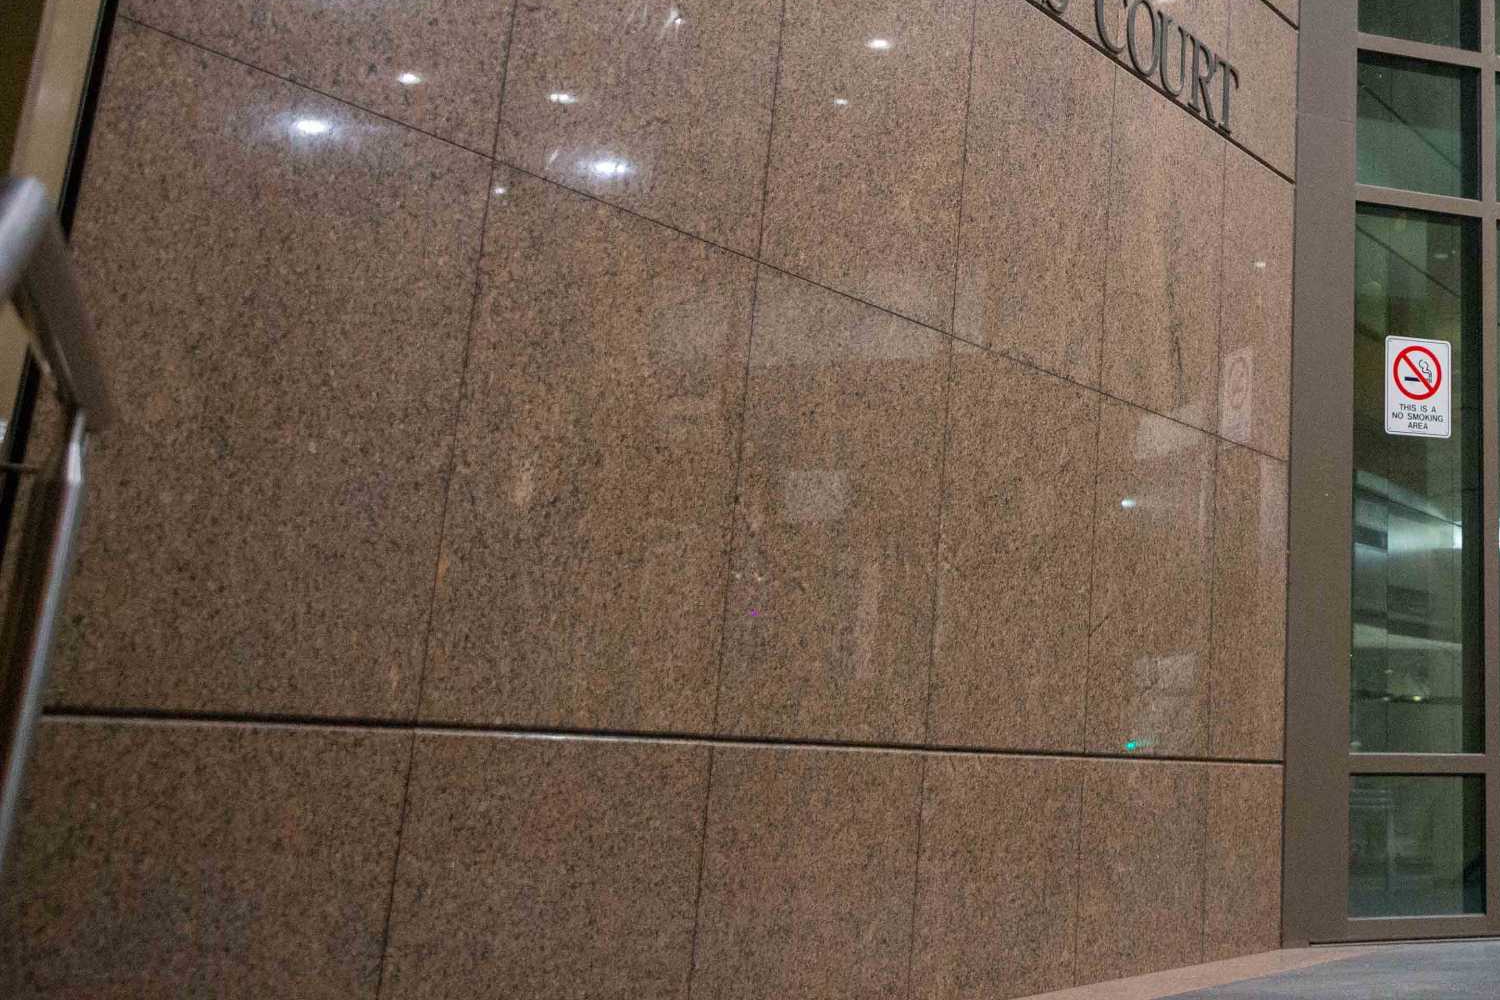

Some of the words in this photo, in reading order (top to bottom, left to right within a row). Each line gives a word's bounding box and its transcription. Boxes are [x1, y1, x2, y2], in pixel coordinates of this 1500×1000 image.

[1400, 403, 1417, 412] THIS
[1420, 405, 1428, 413] IS
[1431, 405, 1437, 413] A
[1392, 411, 1403, 419] NO
[1407, 413, 1443, 423] SMOKING
[1407, 422, 1428, 430] AREA
